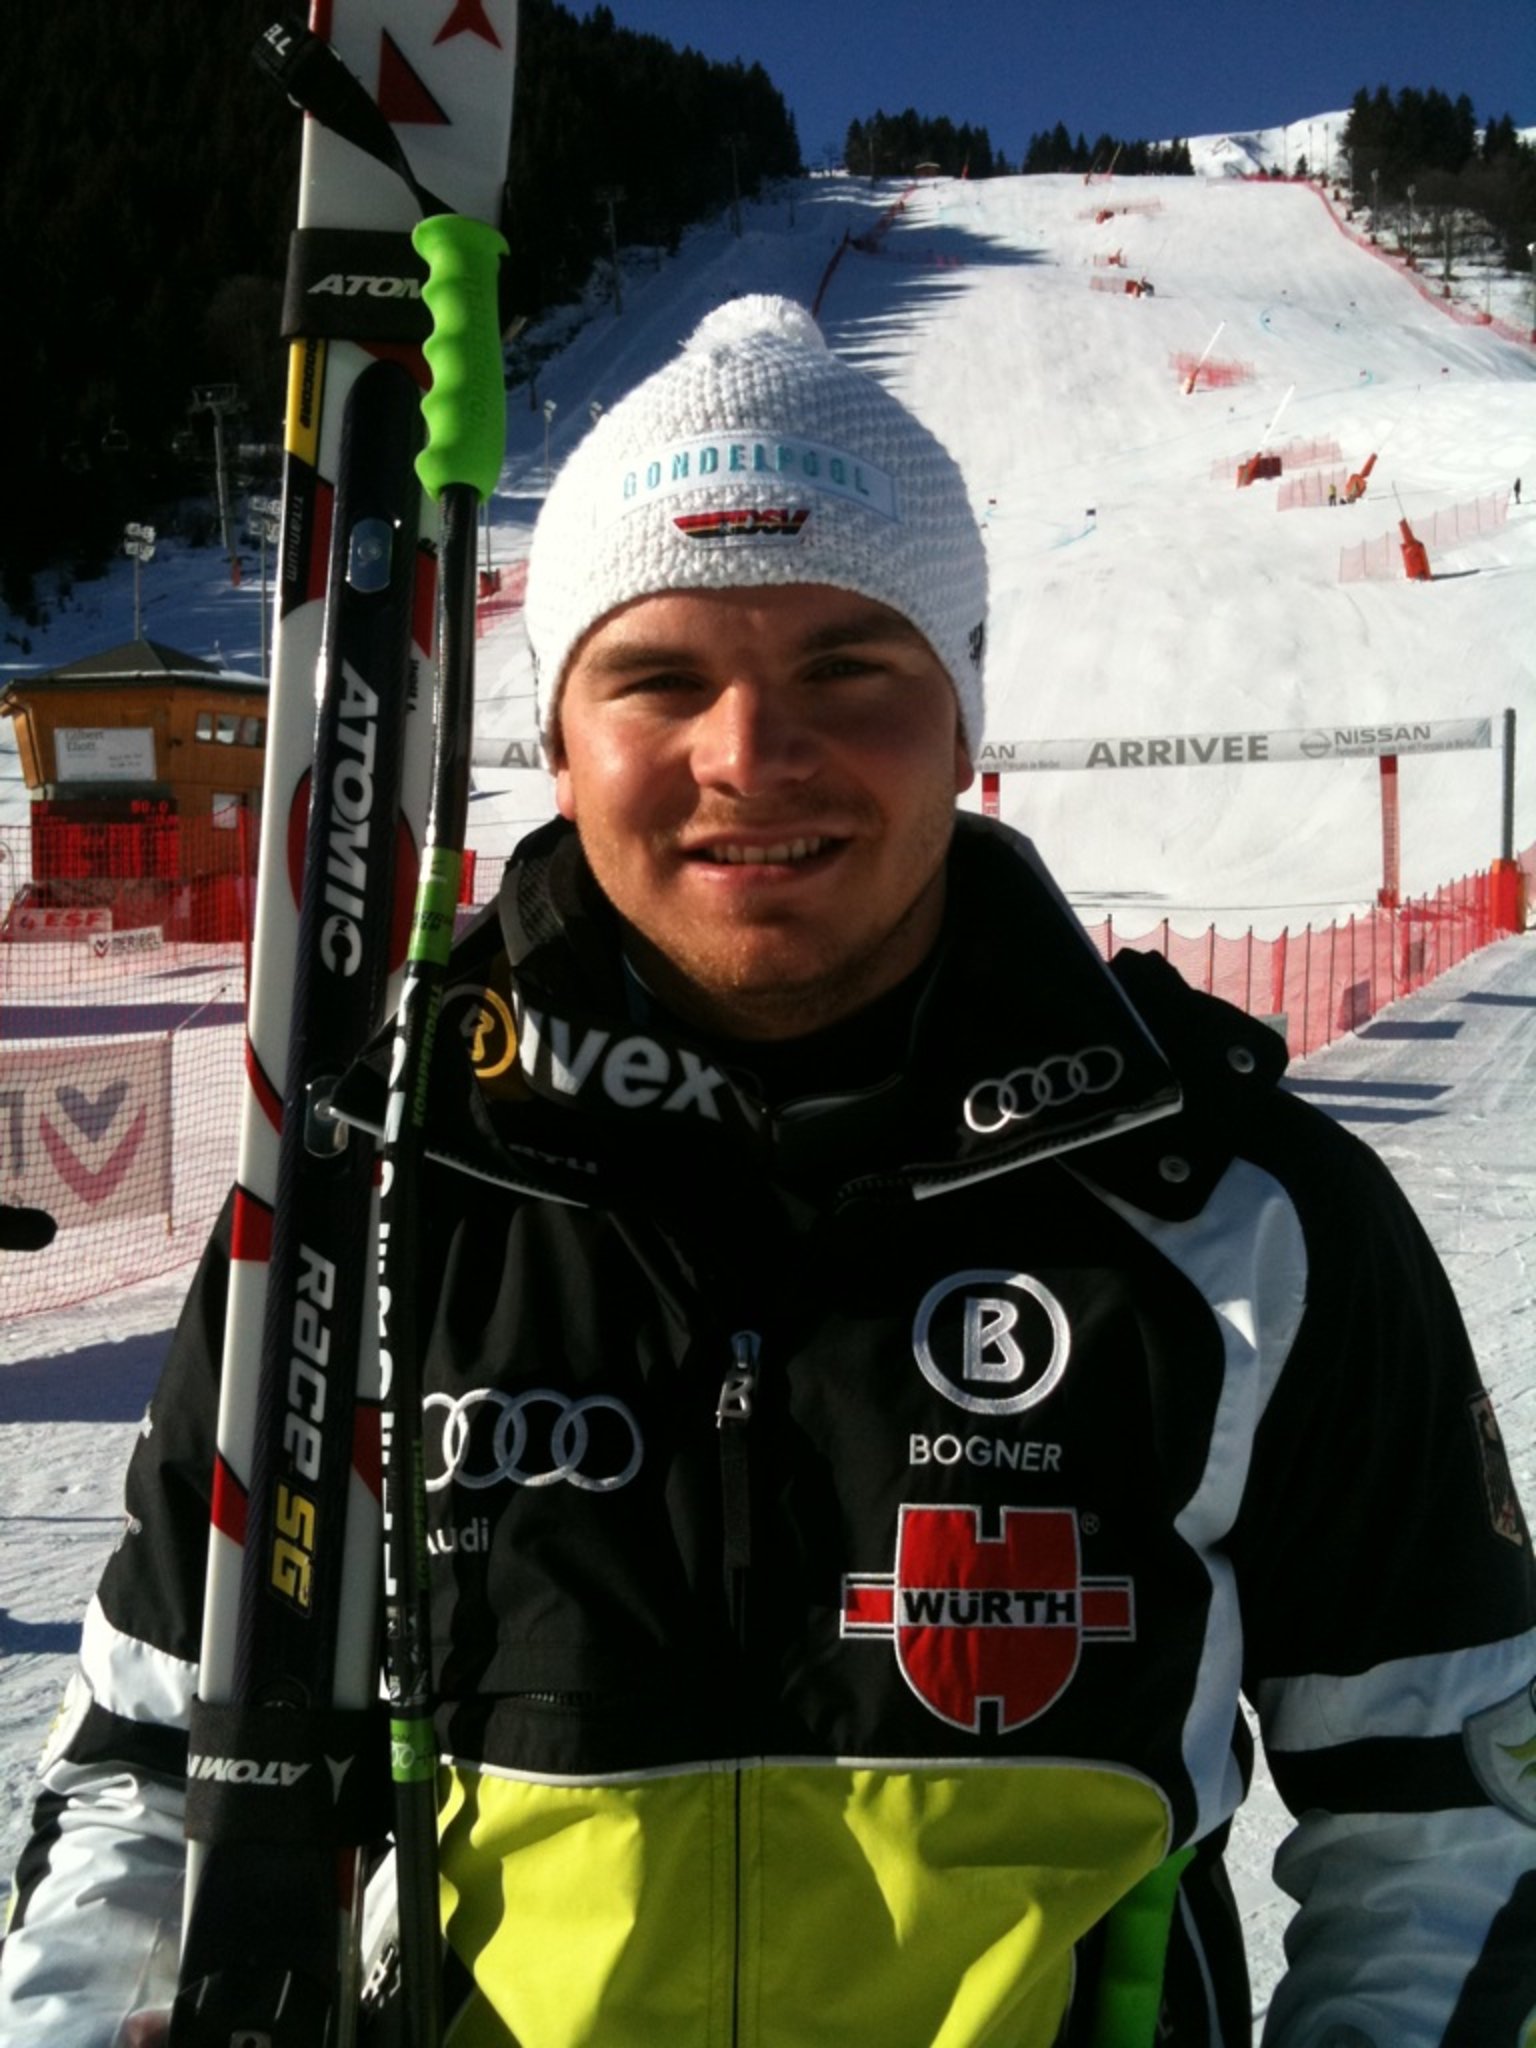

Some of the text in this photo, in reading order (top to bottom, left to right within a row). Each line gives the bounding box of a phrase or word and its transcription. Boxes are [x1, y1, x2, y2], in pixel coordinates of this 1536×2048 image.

[622, 442, 870, 499] GONDELPOOL
[1085, 734, 1269, 768] ARRIVEE
[1334, 725, 1431, 745] NISSAN
[320, 658, 379, 976] ATOMIC
[283, 1243, 336, 1482] Race
[909, 1434, 1062, 1472] BOGNER
